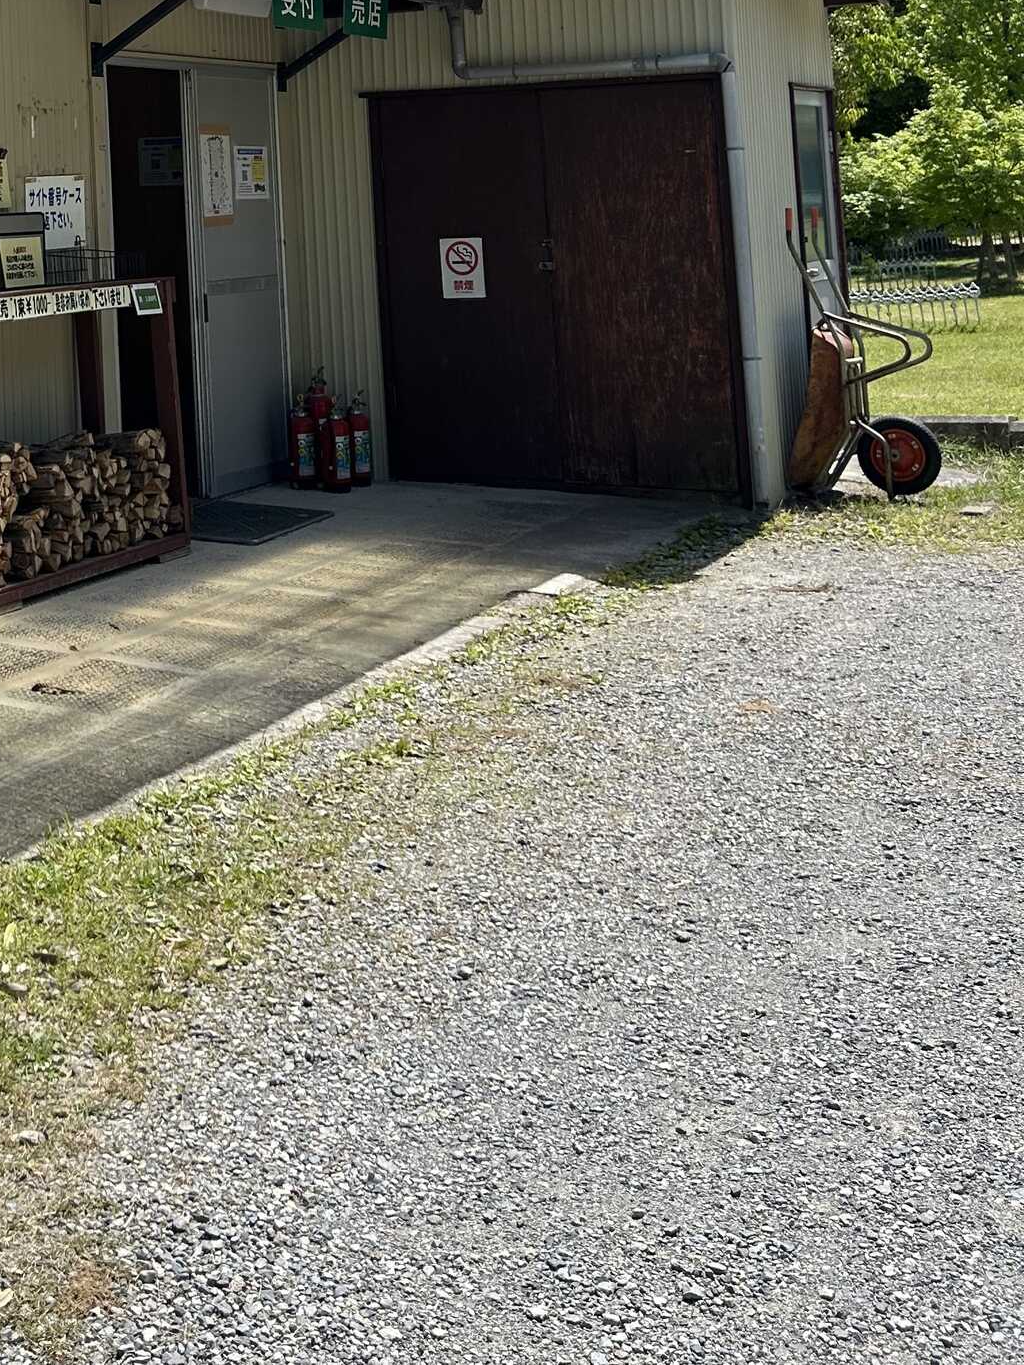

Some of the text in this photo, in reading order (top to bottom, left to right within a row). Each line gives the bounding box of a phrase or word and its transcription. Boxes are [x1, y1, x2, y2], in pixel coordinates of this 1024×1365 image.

[29, 186, 82, 207] サイト番号ケース
